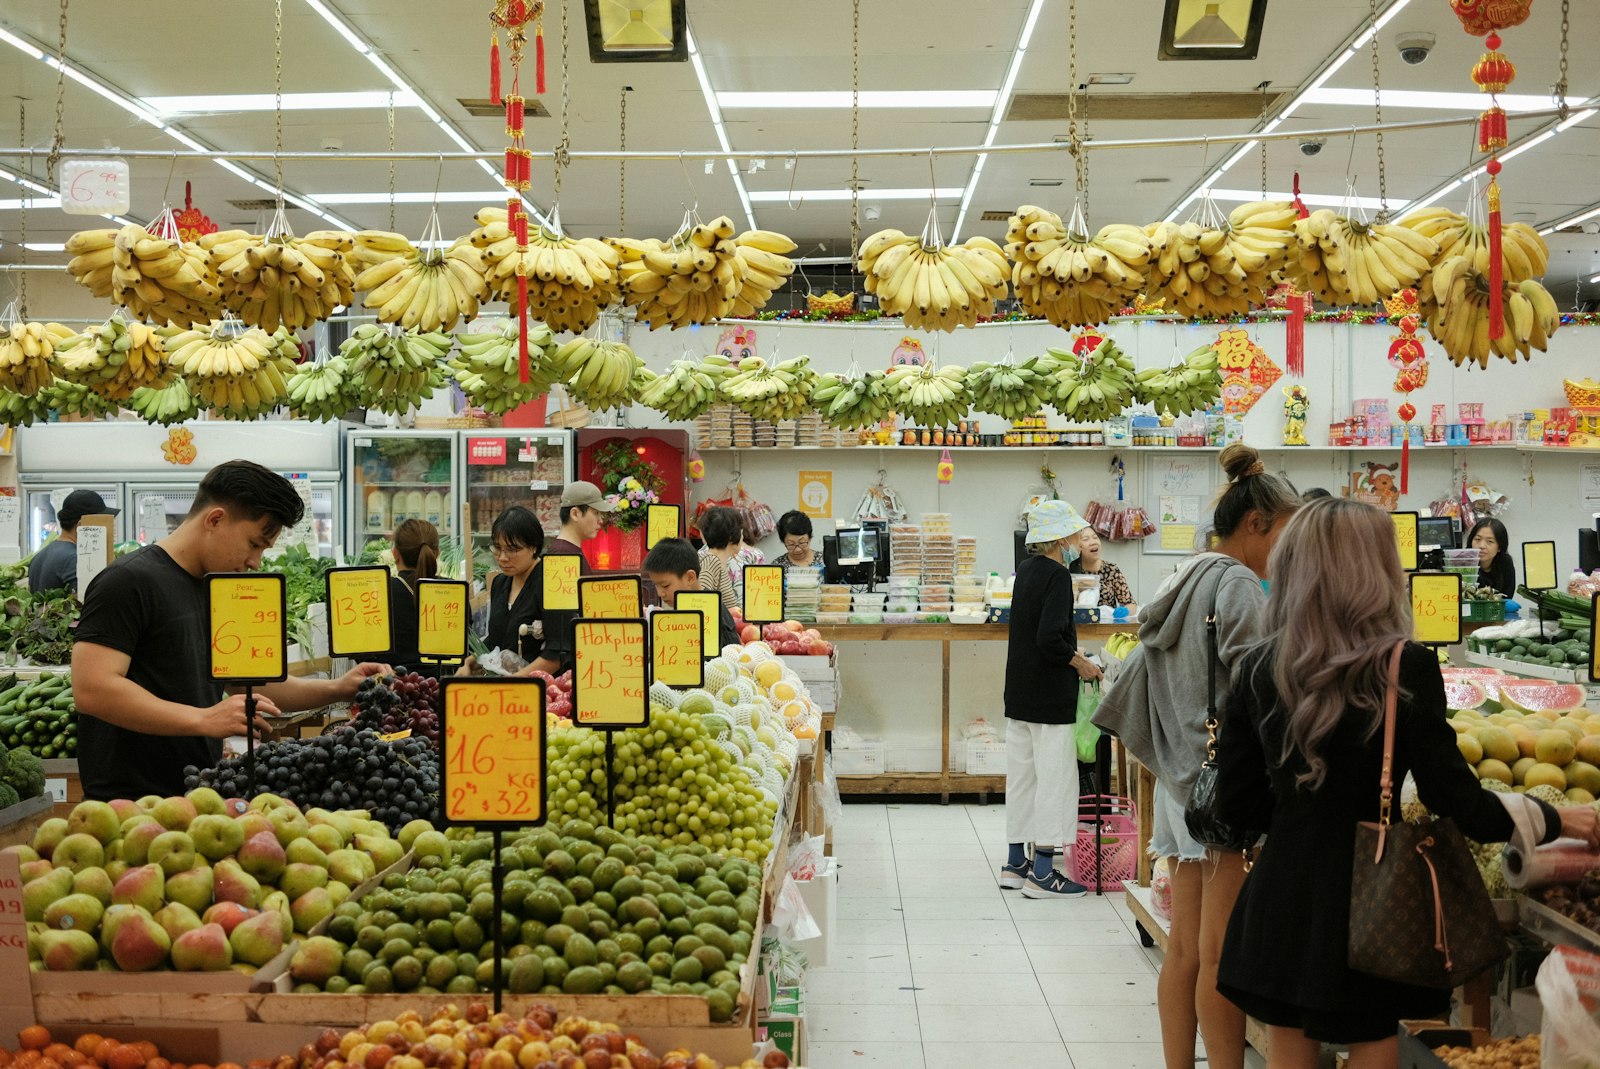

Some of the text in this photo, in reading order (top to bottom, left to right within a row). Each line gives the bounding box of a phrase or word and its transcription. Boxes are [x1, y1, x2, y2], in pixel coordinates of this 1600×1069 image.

[71, 170, 93, 201] 6
[564, 566, 577, 578] 99
[749, 567, 780, 585] Papple
[562, 586, 577, 594] KG
[591, 581, 630, 595] Grapes
[335, 591, 379, 626] 13 99
[443, 602, 459, 615] 99
[364, 615, 383, 627] KG
[658, 615, 699, 633] Guava
[213, 610, 277, 654] 6 99
[251, 646, 274, 659] KG
[622, 687, 643, 699] KG
[447, 687, 489, 717] Táo
[506, 725, 533, 742] 99
[507, 773, 538, 789] KG
[773, 1030, 793, 1038] Class
